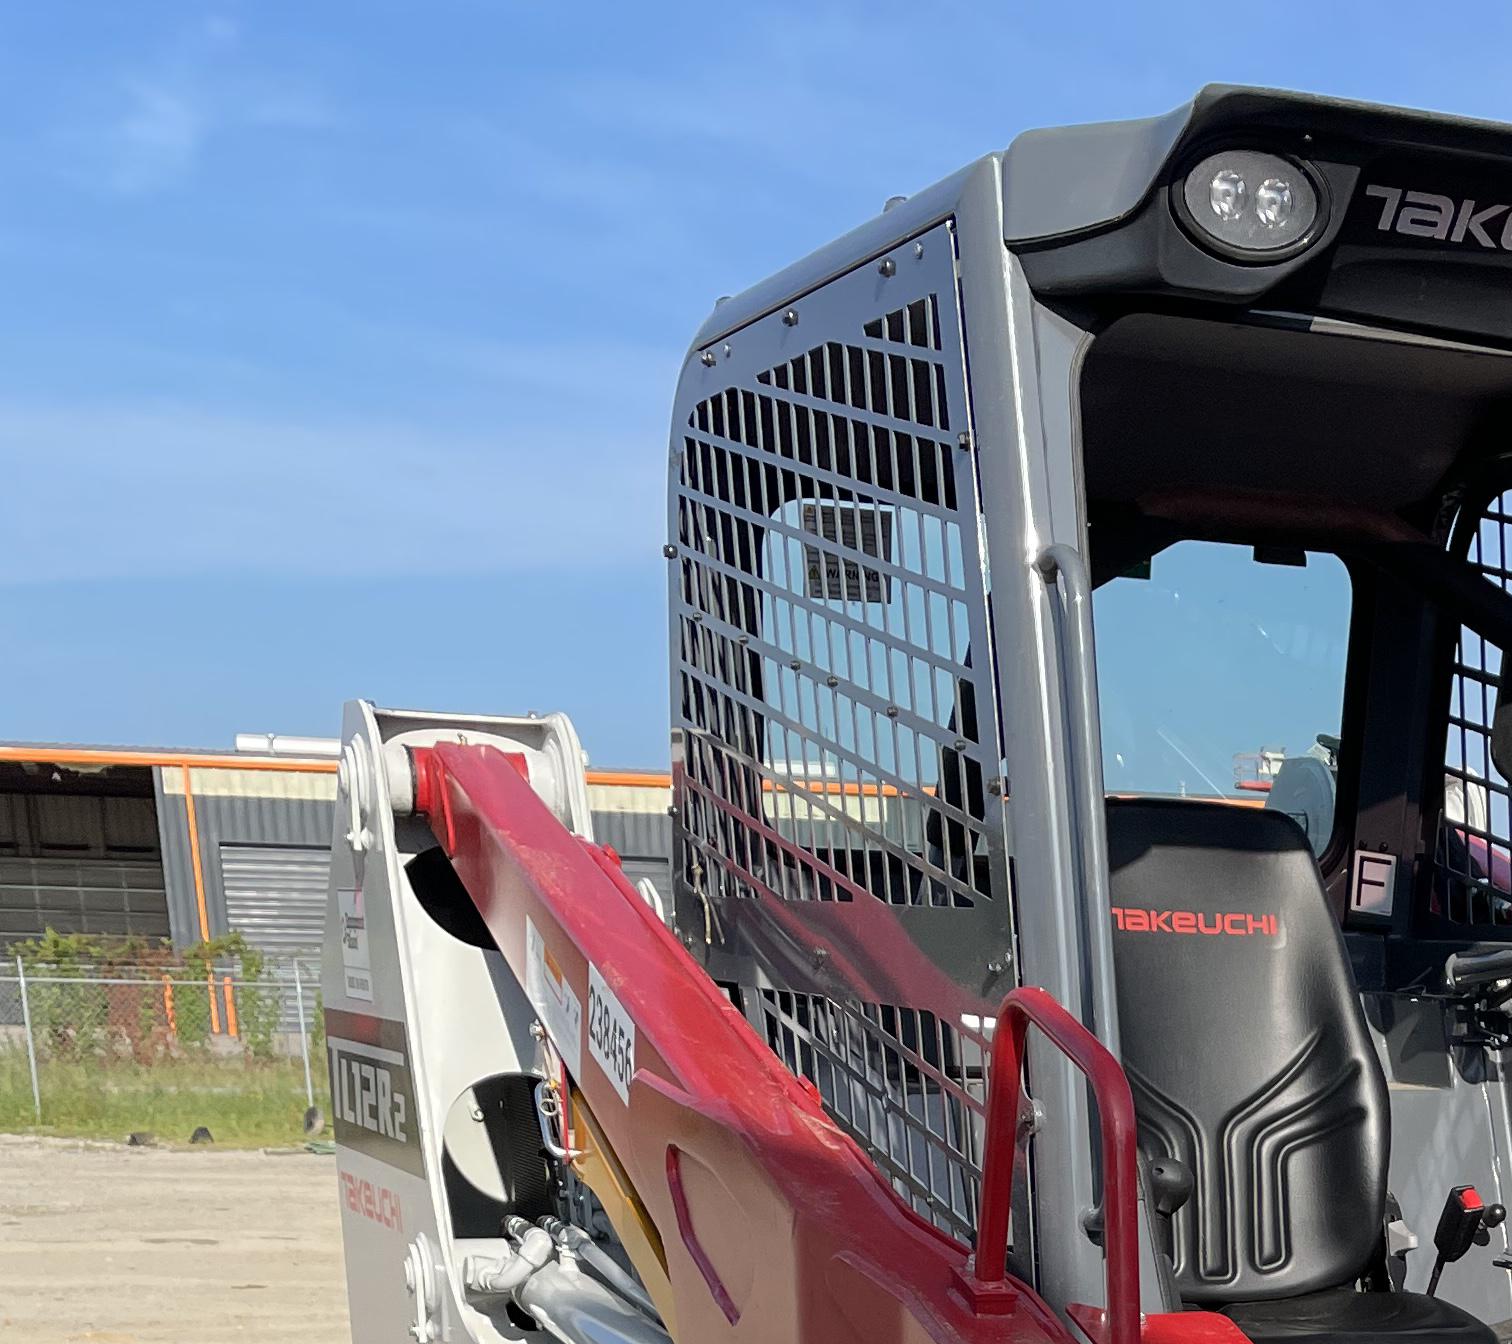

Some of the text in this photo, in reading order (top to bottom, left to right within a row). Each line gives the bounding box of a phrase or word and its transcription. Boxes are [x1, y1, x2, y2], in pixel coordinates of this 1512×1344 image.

[827, 567, 880, 582] WRNNG
[1111, 907, 1278, 937] TAKEUCHI
[588, 984, 633, 1088] 238456
[340, 1171, 404, 1234] TAKEUCHI
